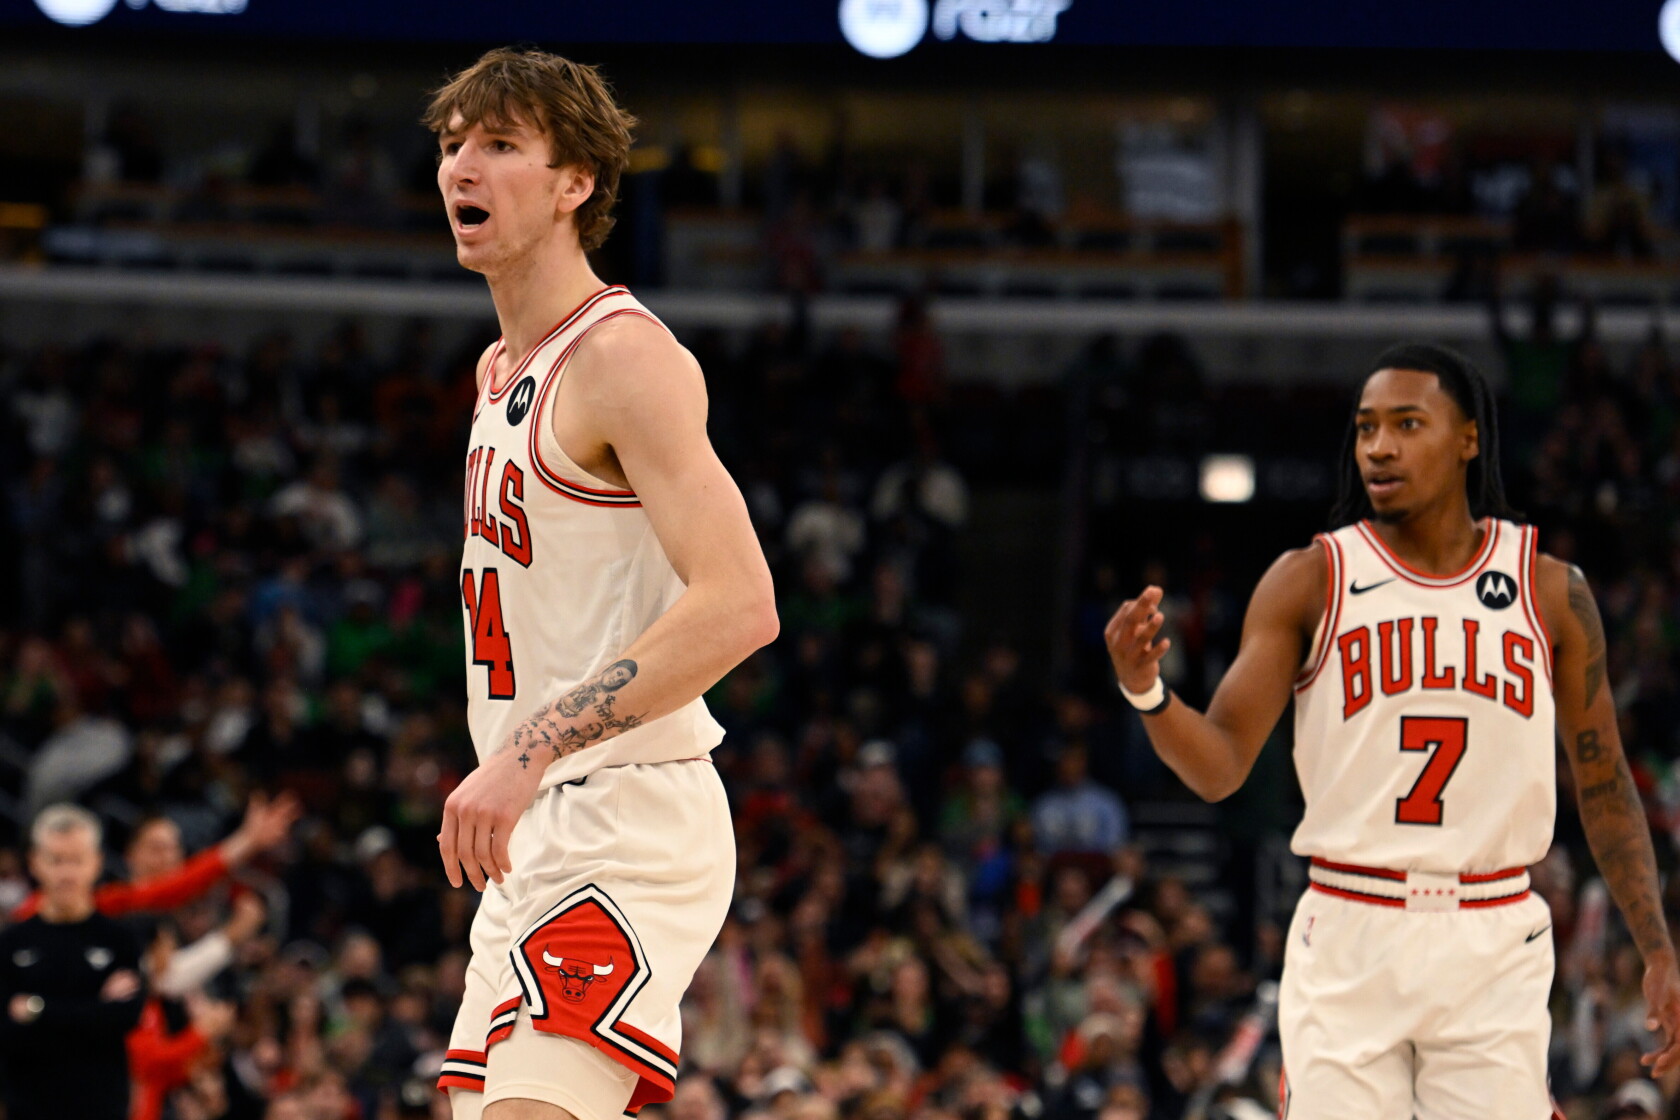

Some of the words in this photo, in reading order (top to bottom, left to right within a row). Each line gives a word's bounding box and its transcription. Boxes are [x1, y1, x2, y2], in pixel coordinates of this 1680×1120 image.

[463, 445, 533, 569] ULLS
[462, 567, 516, 701] 14
[1338, 616, 1534, 722] BULLS
[1395, 715, 1469, 826] 7
